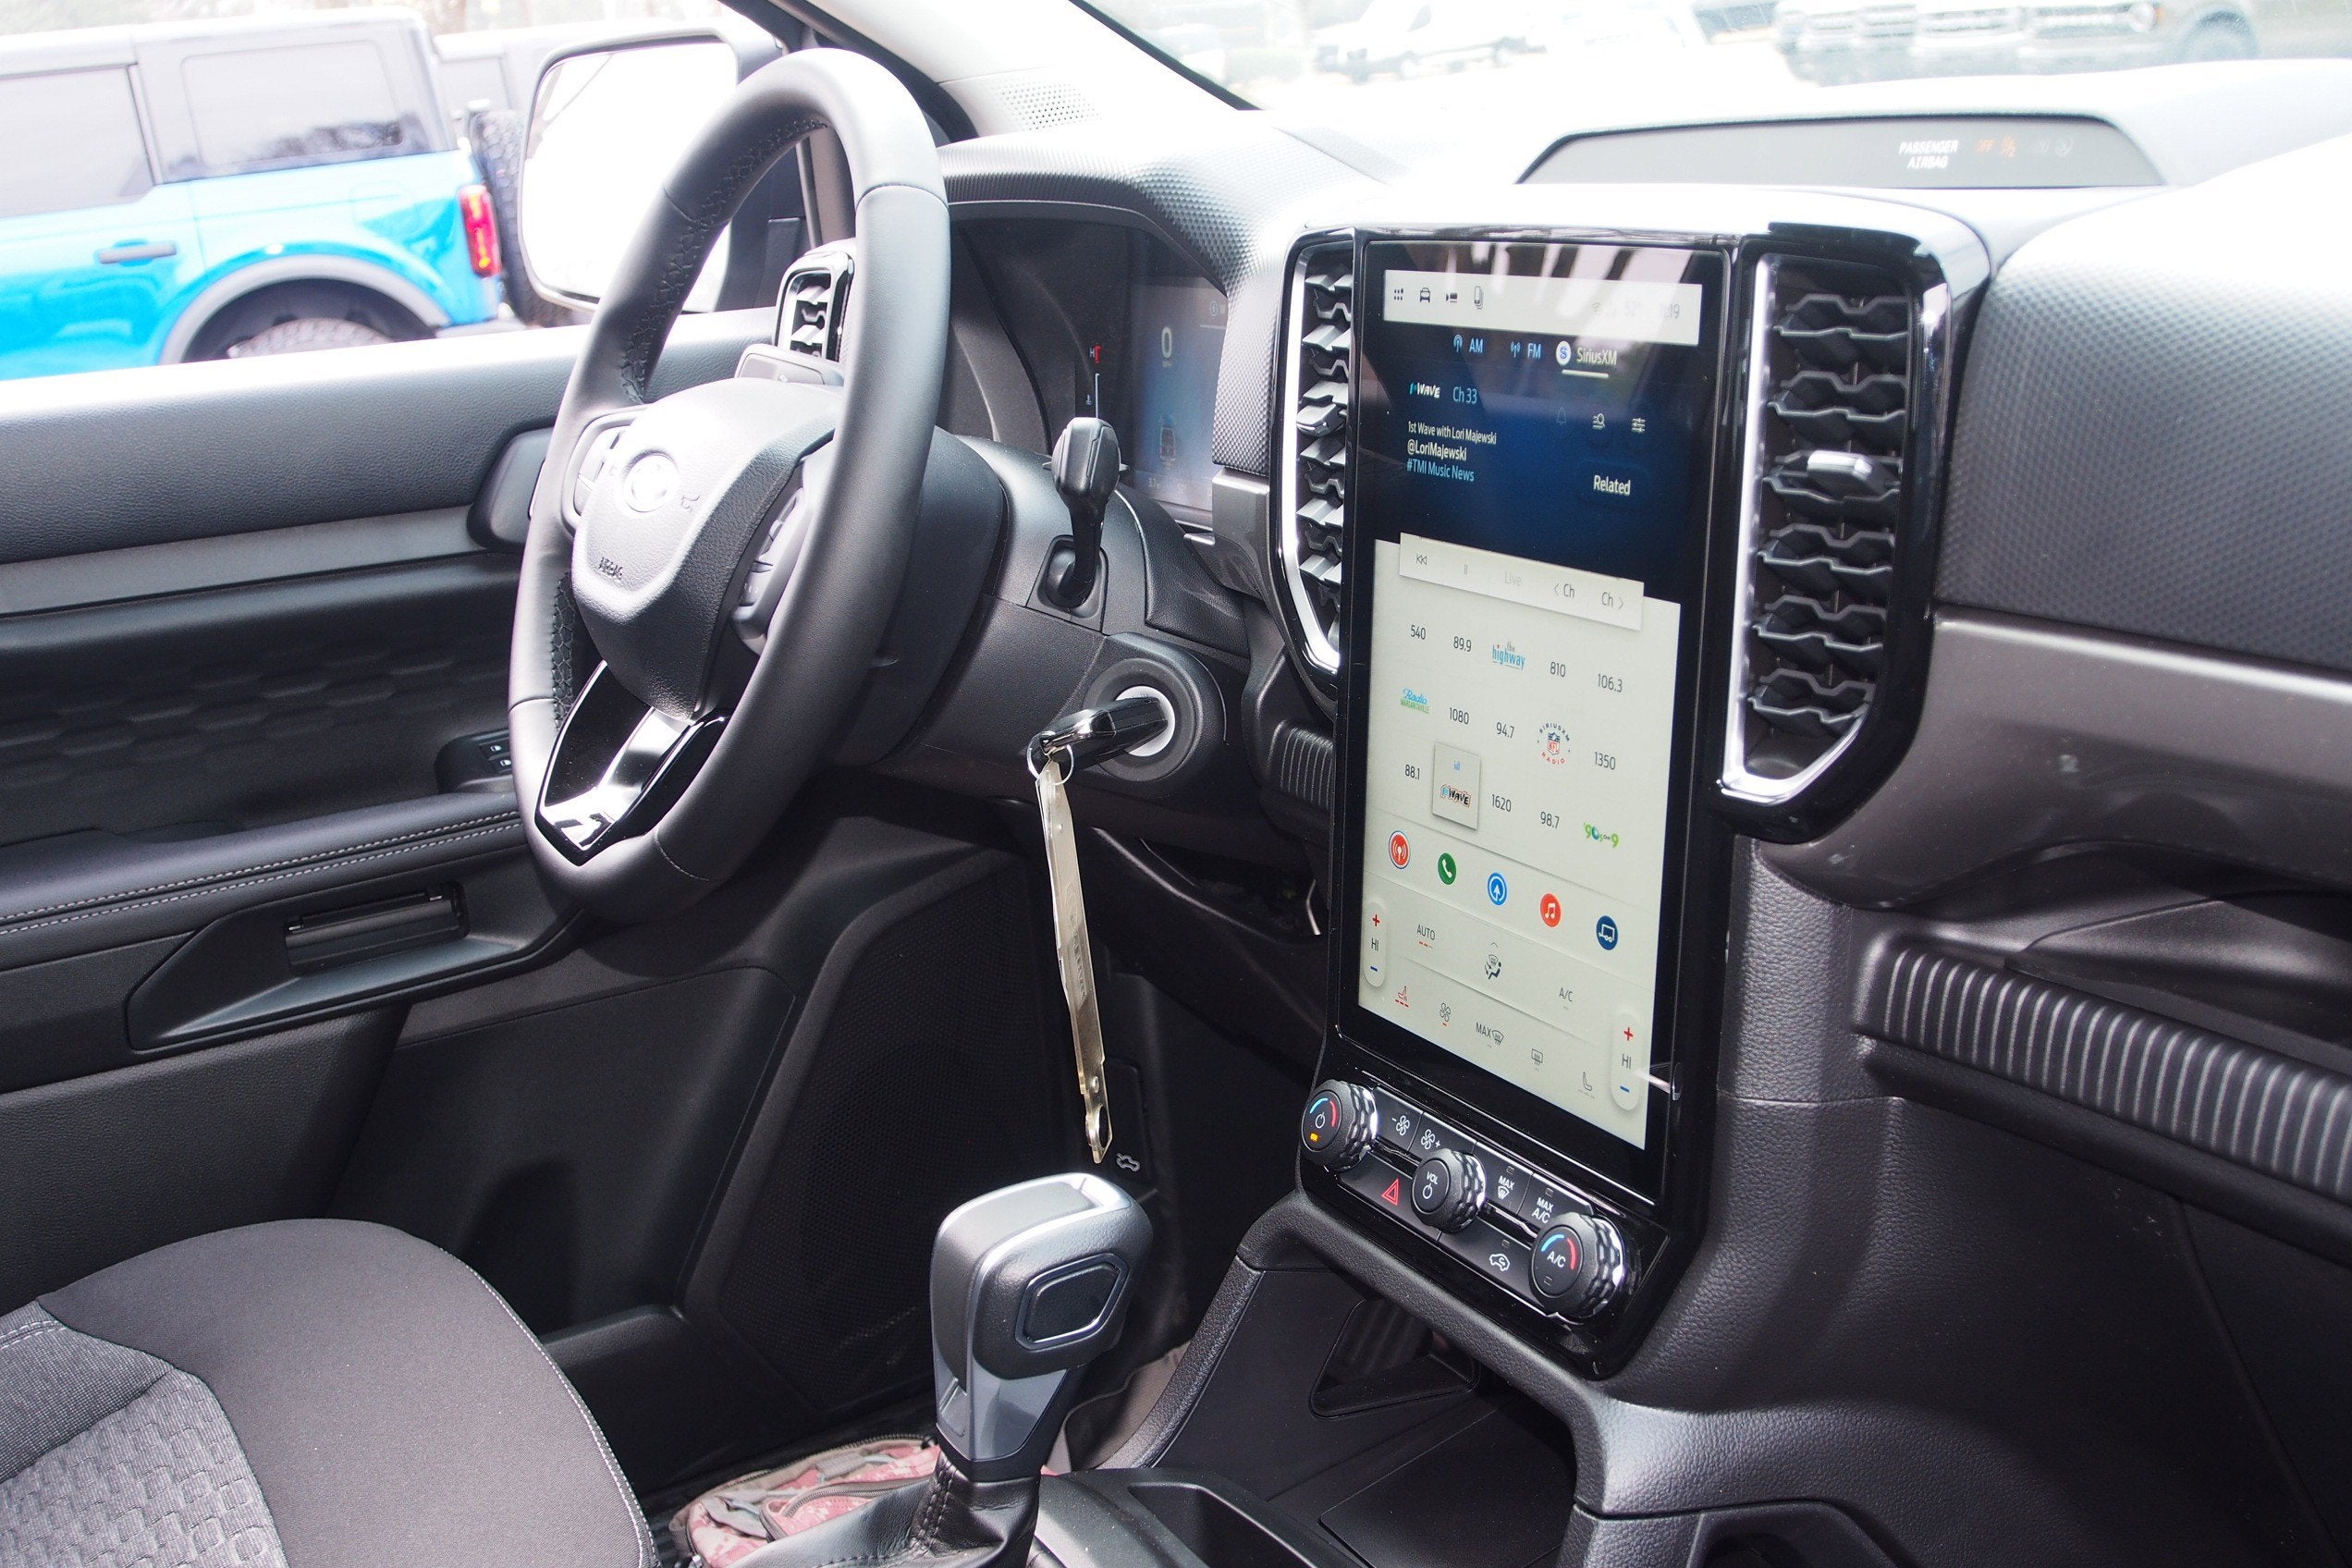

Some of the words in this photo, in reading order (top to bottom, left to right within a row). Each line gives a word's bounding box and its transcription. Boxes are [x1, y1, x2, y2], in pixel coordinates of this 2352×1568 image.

[1899, 140, 1958, 154] PASSENGER
[1906, 155, 1949, 169] AIRBAG
[1469, 338, 1483, 353] AM
[1528, 343, 1541, 358] FM
[1576, 347, 1617, 366] SiriusXM
[1452, 386, 1464, 403] Ch
[1466, 388, 1477, 404] 33
[1408, 421, 1417, 434] 1st
[1417, 423, 1436, 436] Wave
[1436, 425, 1452, 438] with
[1452, 427, 1464, 440] Lori
[1465, 428, 1497, 445] Majewski
[1407, 439, 1467, 461] @LoriMajewski
[1406, 459, 1427, 473] #TMI
[1427, 461, 1451, 477] Music
[1452, 465, 1475, 482] News
[1594, 475, 1631, 496] Related
[1504, 570, 1522, 587] Live
[1563, 582, 1575, 598] Ch
[1601, 592, 1614, 607] Ch
[1410, 624, 1427, 640] 540
[1453, 636, 1472, 652] 89.9
[1491, 643, 1525, 670] highway
[1550, 661, 1566, 678] 810
[1597, 672, 1623, 692] 106.3
[1403, 688, 1427, 704] Radio
[1449, 706, 1470, 725] 1080
[1496, 722, 1515, 740] 94.7
[1594, 751, 1616, 770] 1350
[1404, 764, 1420, 780] 88.1
[1491, 793, 1512, 812] 1620
[1539, 811, 1560, 829] 98.7
[1416, 924, 1436, 941] AUTO
[1371, 938, 1378, 951] HI
[1559, 986, 1573, 1003] A/C
[1476, 1021, 1491, 1039] MAX
[1622, 1053, 1631, 1069] HI
[1426, 1170, 1439, 1185] VOL
[1498, 1174, 1514, 1190] MAX
[1537, 1197, 1553, 1213] MAX
[1531, 1207, 1550, 1224] A/C
[1547, 1252, 1565, 1269] A/C
